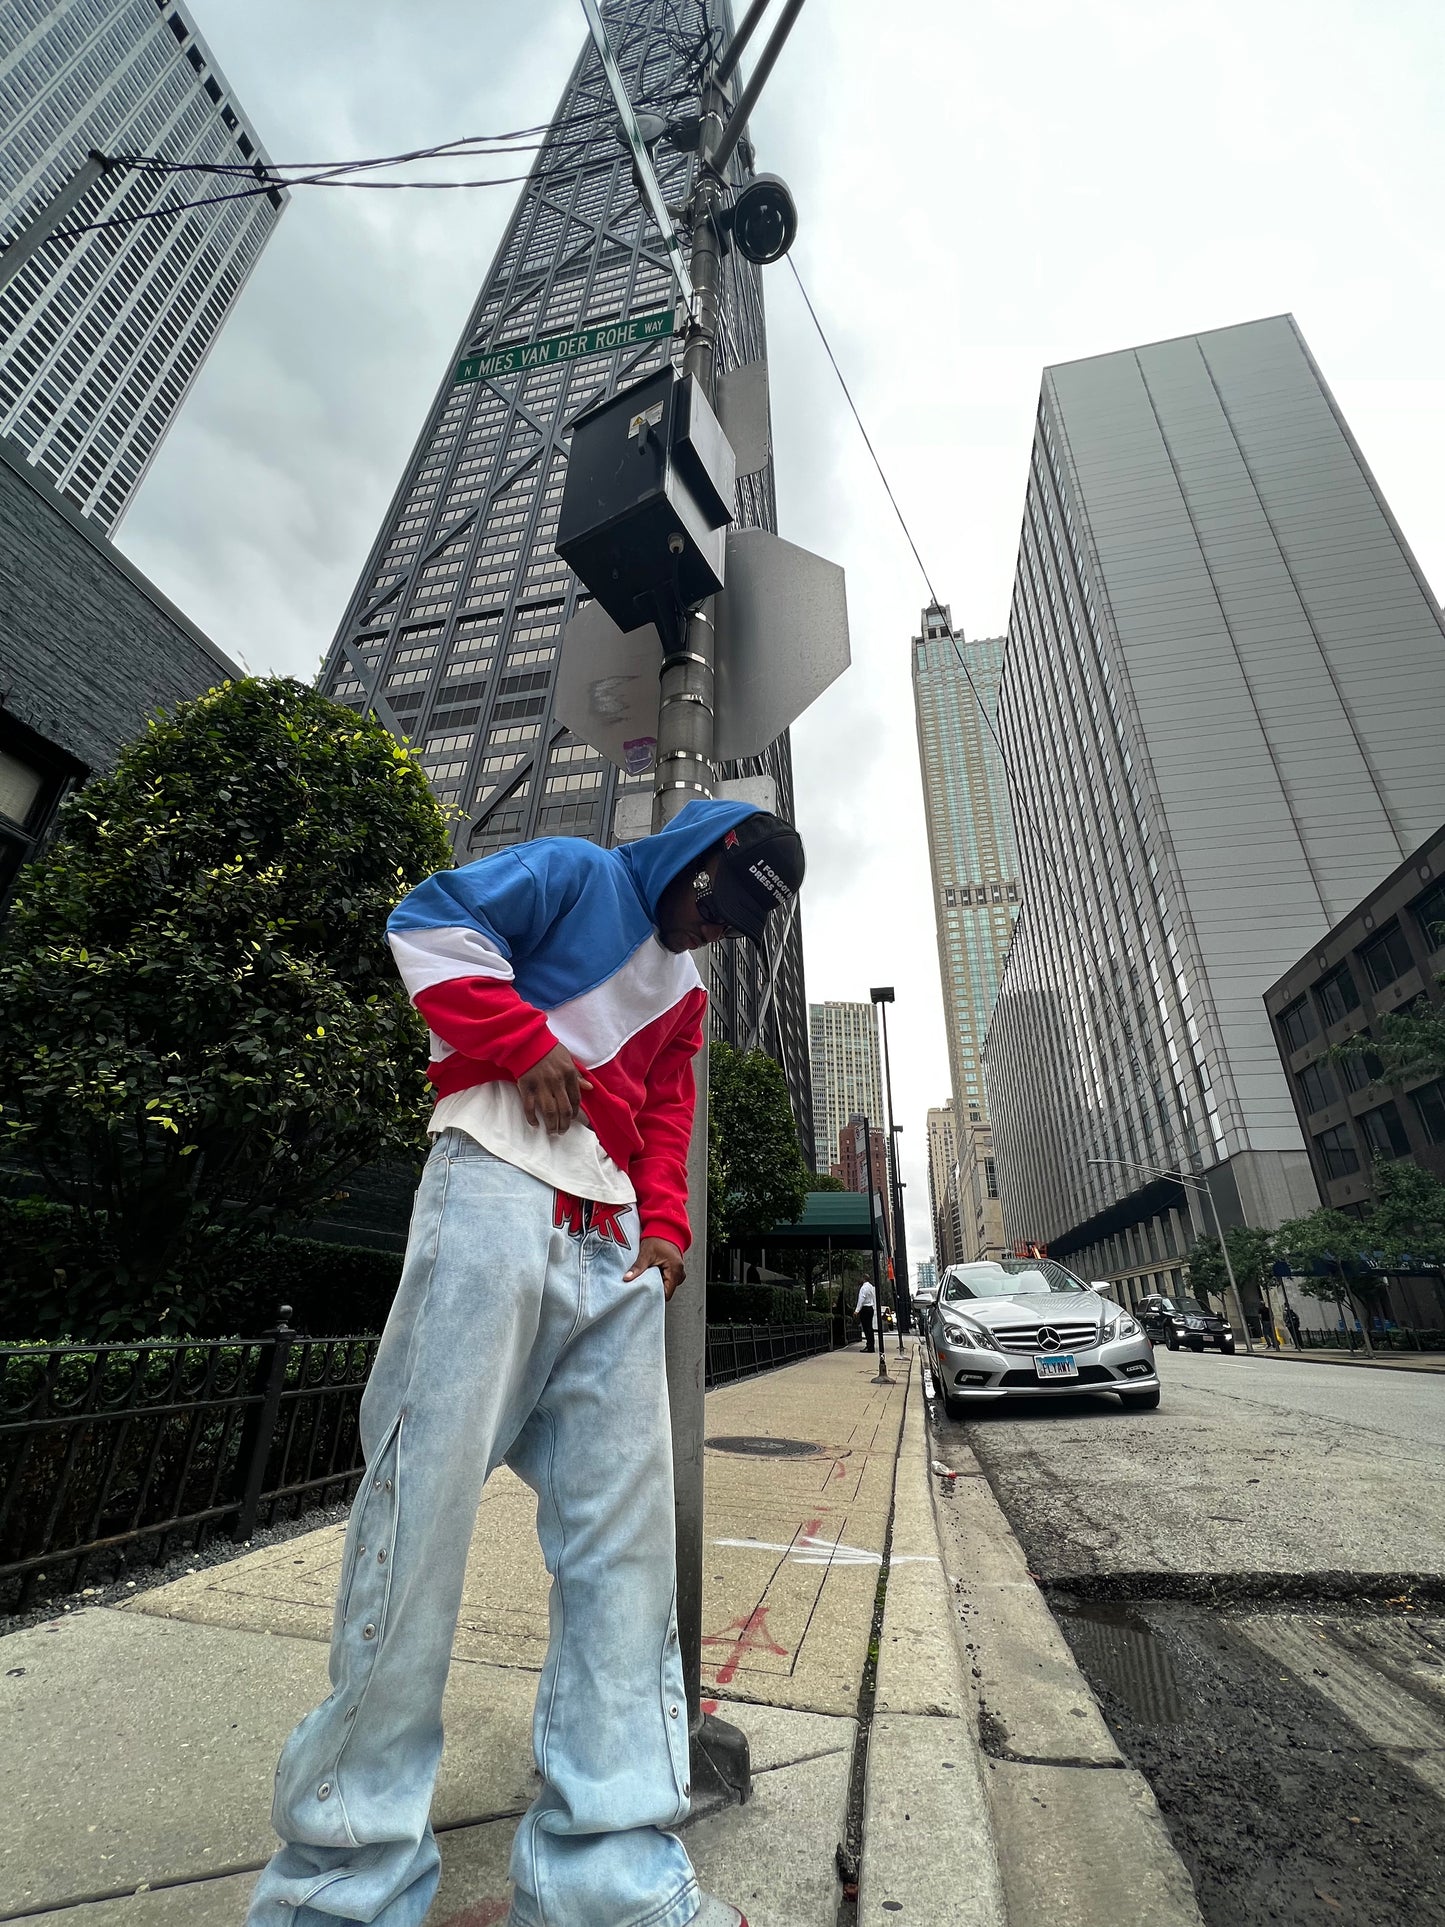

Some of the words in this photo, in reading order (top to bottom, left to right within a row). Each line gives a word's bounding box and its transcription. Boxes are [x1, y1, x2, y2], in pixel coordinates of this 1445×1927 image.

[465, 366, 472, 376] N
[478, 353, 513, 376] MIES
[521, 344, 551, 366] VAN
[557, 336, 587, 357] DER
[596, 323, 638, 348] ROHE
[645, 319, 664, 334] WAY
[749, 865, 775, 890] DRESS
